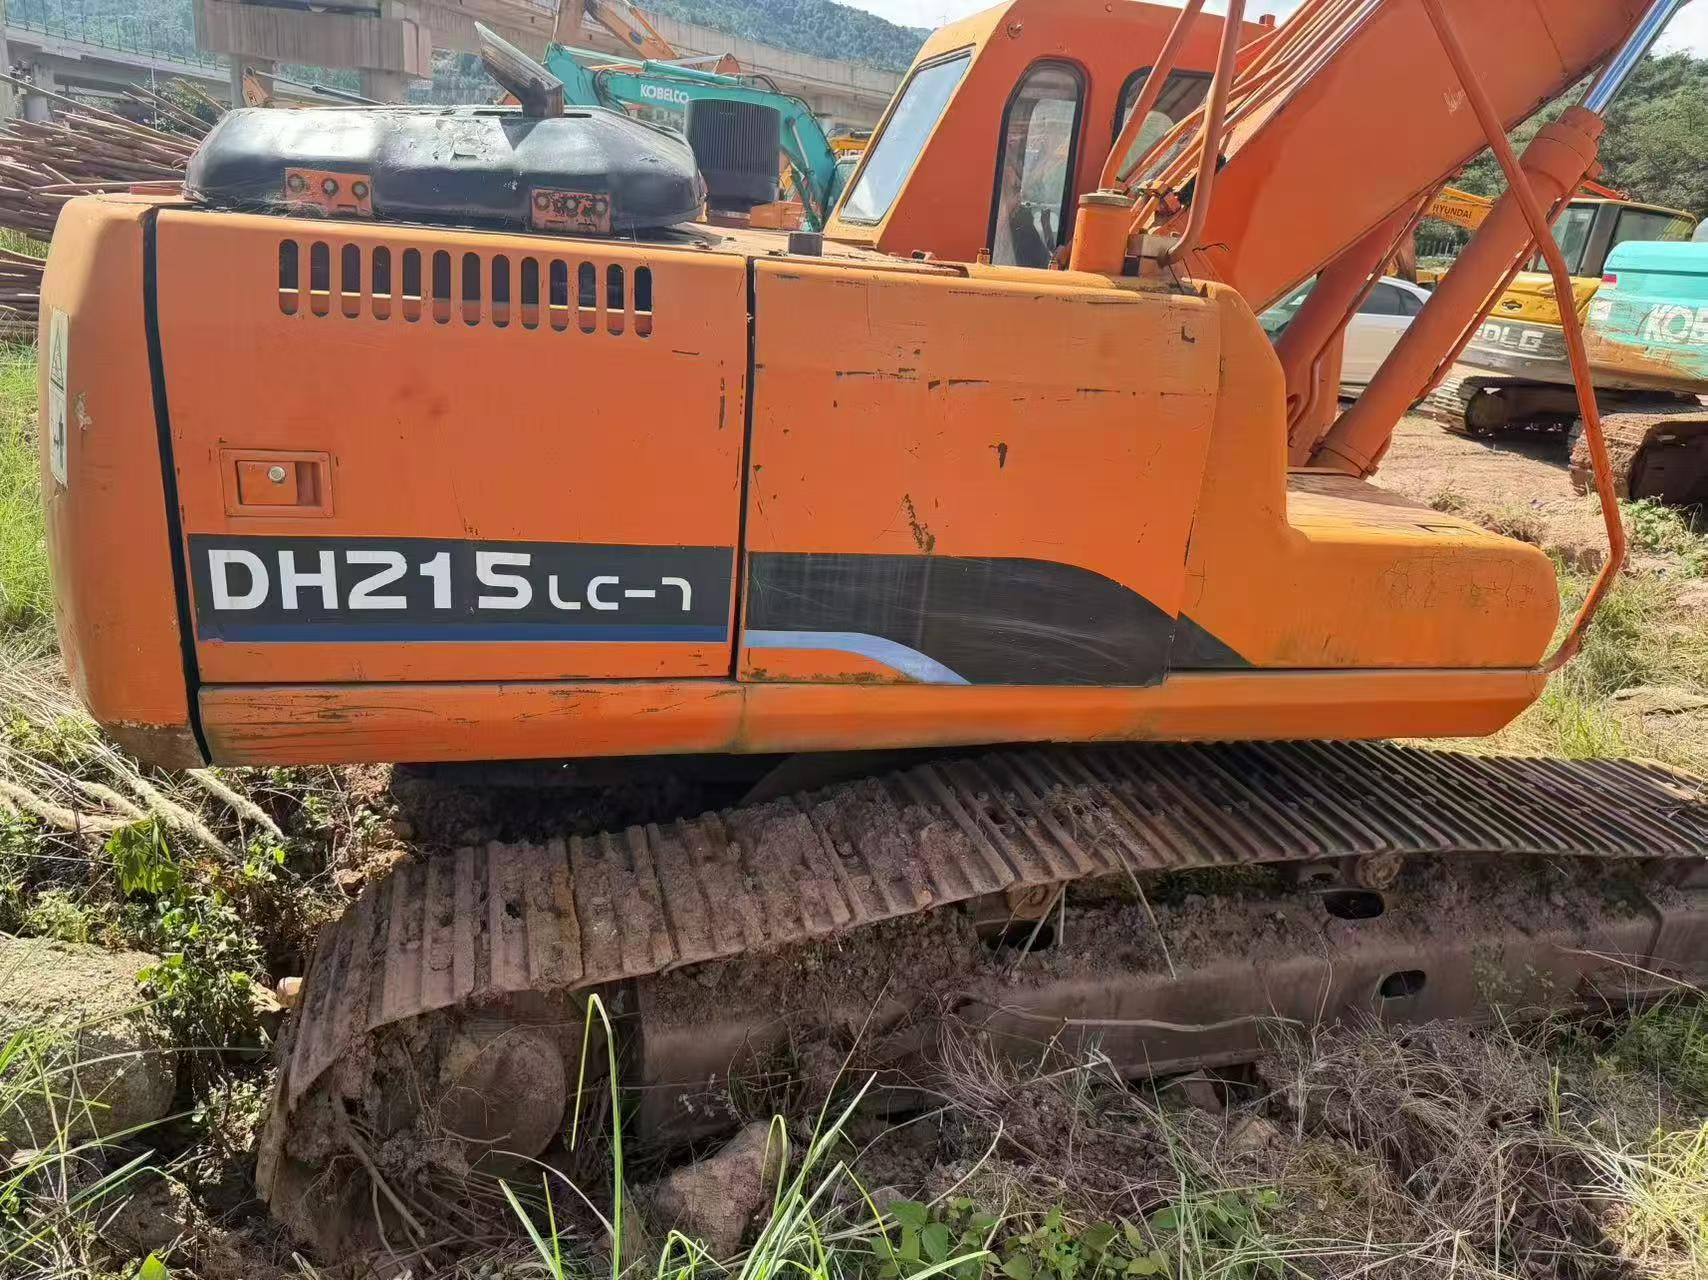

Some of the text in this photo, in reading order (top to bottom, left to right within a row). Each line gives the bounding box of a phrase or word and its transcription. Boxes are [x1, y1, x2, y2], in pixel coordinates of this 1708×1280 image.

[640, 84, 689, 104] KOBELCO
[1432, 203, 1472, 219] HYUNDAI
[208, 549, 533, 611] DH215
